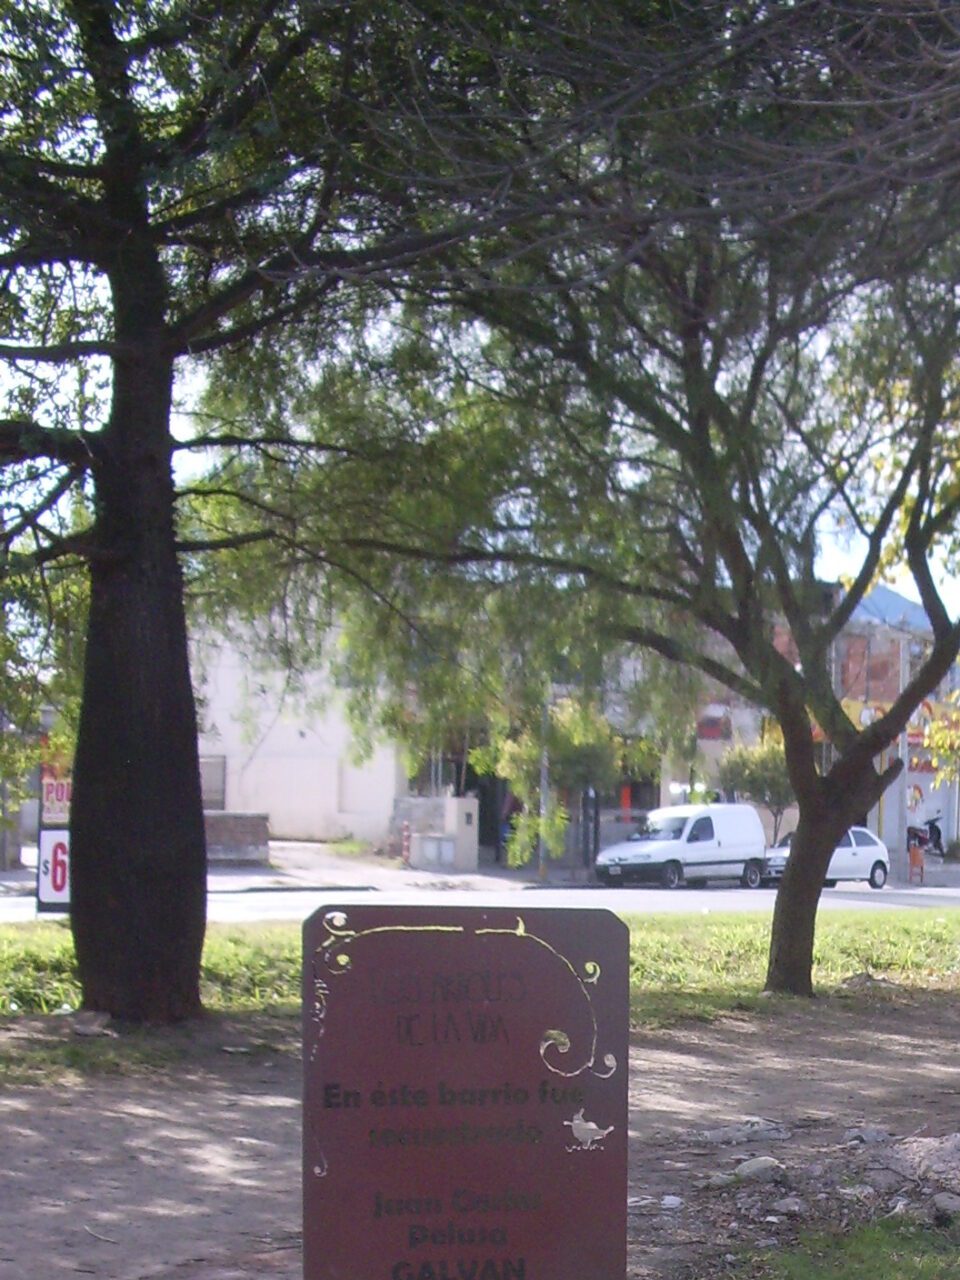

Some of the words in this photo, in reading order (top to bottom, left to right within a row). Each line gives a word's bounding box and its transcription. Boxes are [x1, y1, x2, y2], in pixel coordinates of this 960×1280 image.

[323, 1083, 361, 1108] En
[438, 1081, 529, 1107] barrio
[540, 1079, 584, 1105] fue
[374, 1191, 442, 1218] Juan
